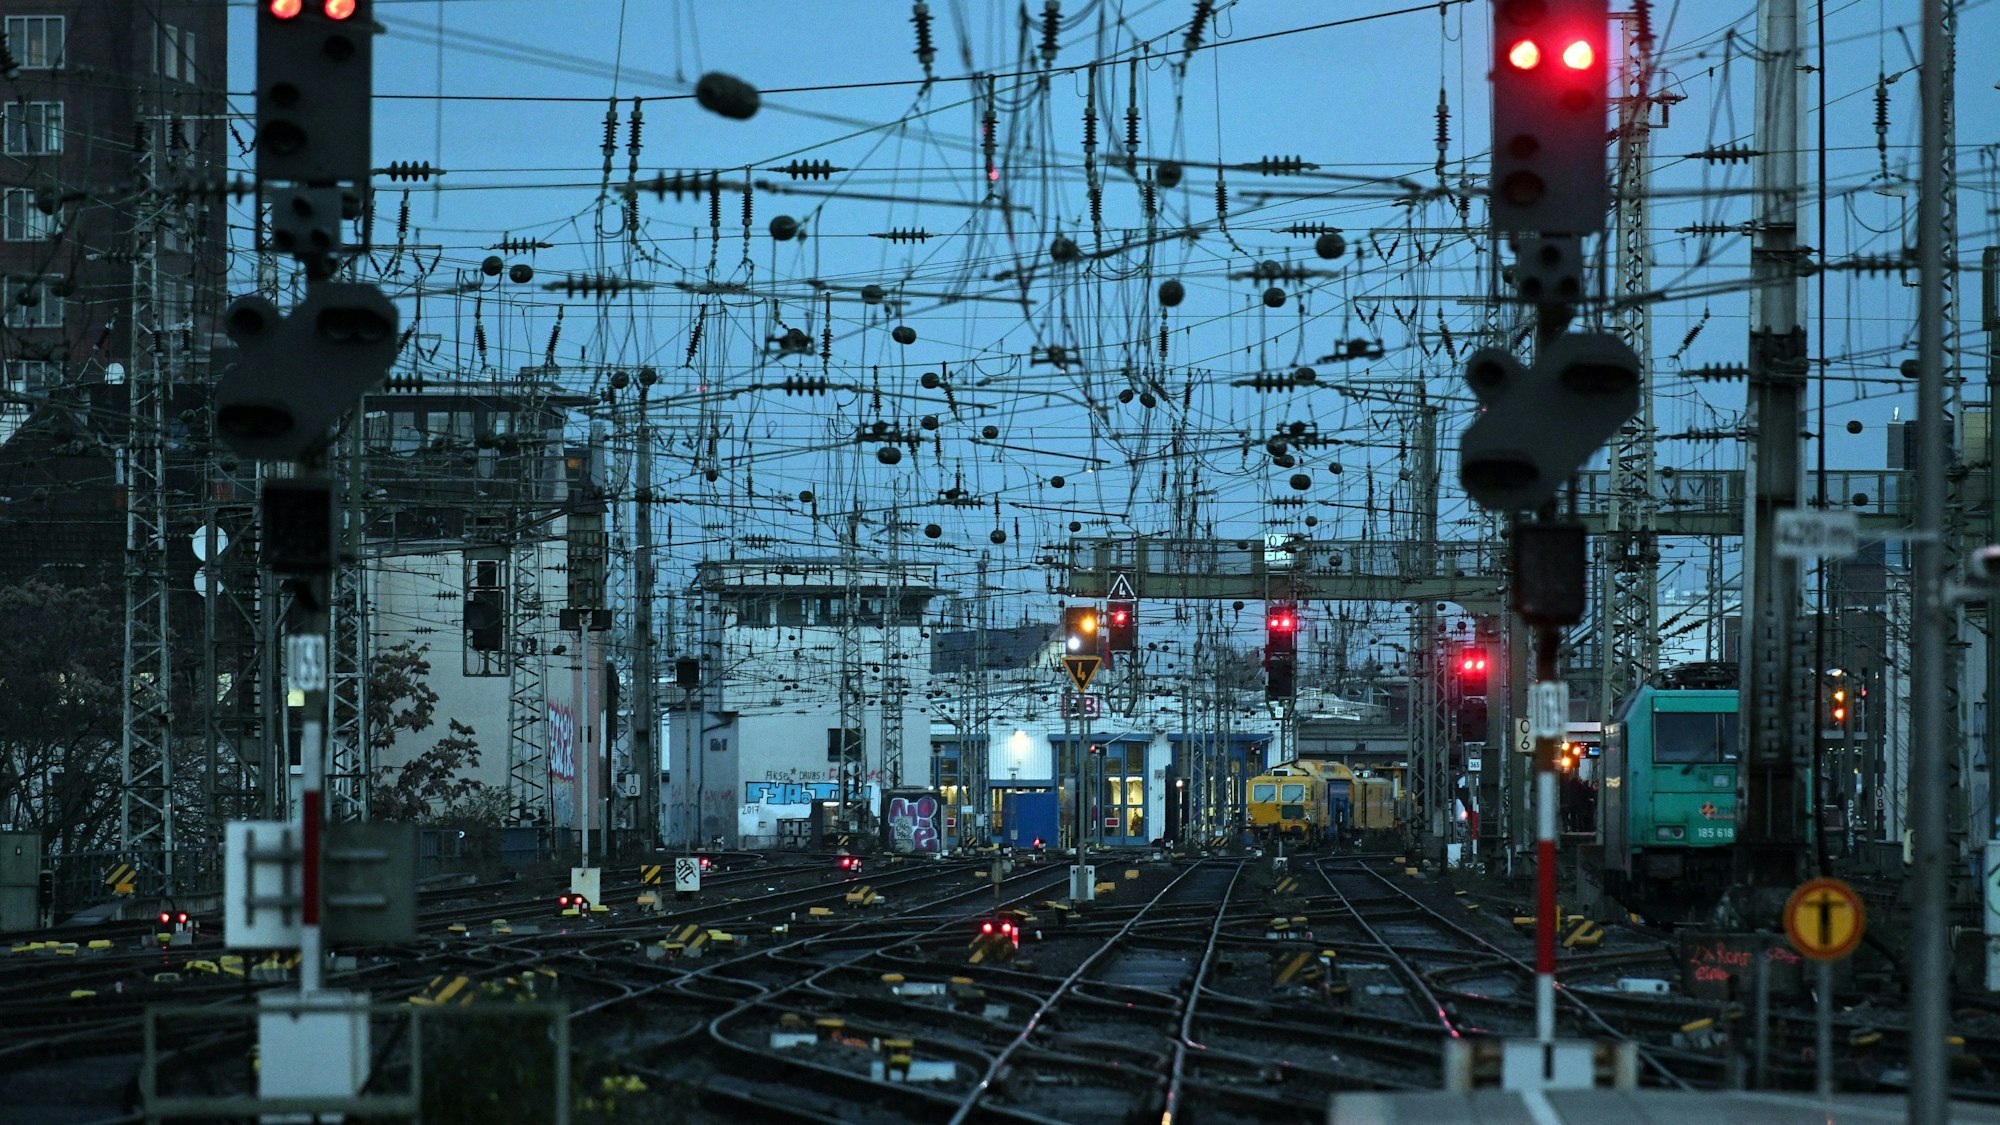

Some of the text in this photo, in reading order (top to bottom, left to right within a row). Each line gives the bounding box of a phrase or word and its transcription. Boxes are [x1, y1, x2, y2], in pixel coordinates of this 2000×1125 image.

[1077, 661, 1086, 680] 4
[742, 805, 759, 815] 2017
[1698, 828, 1734, 838] 185 618
